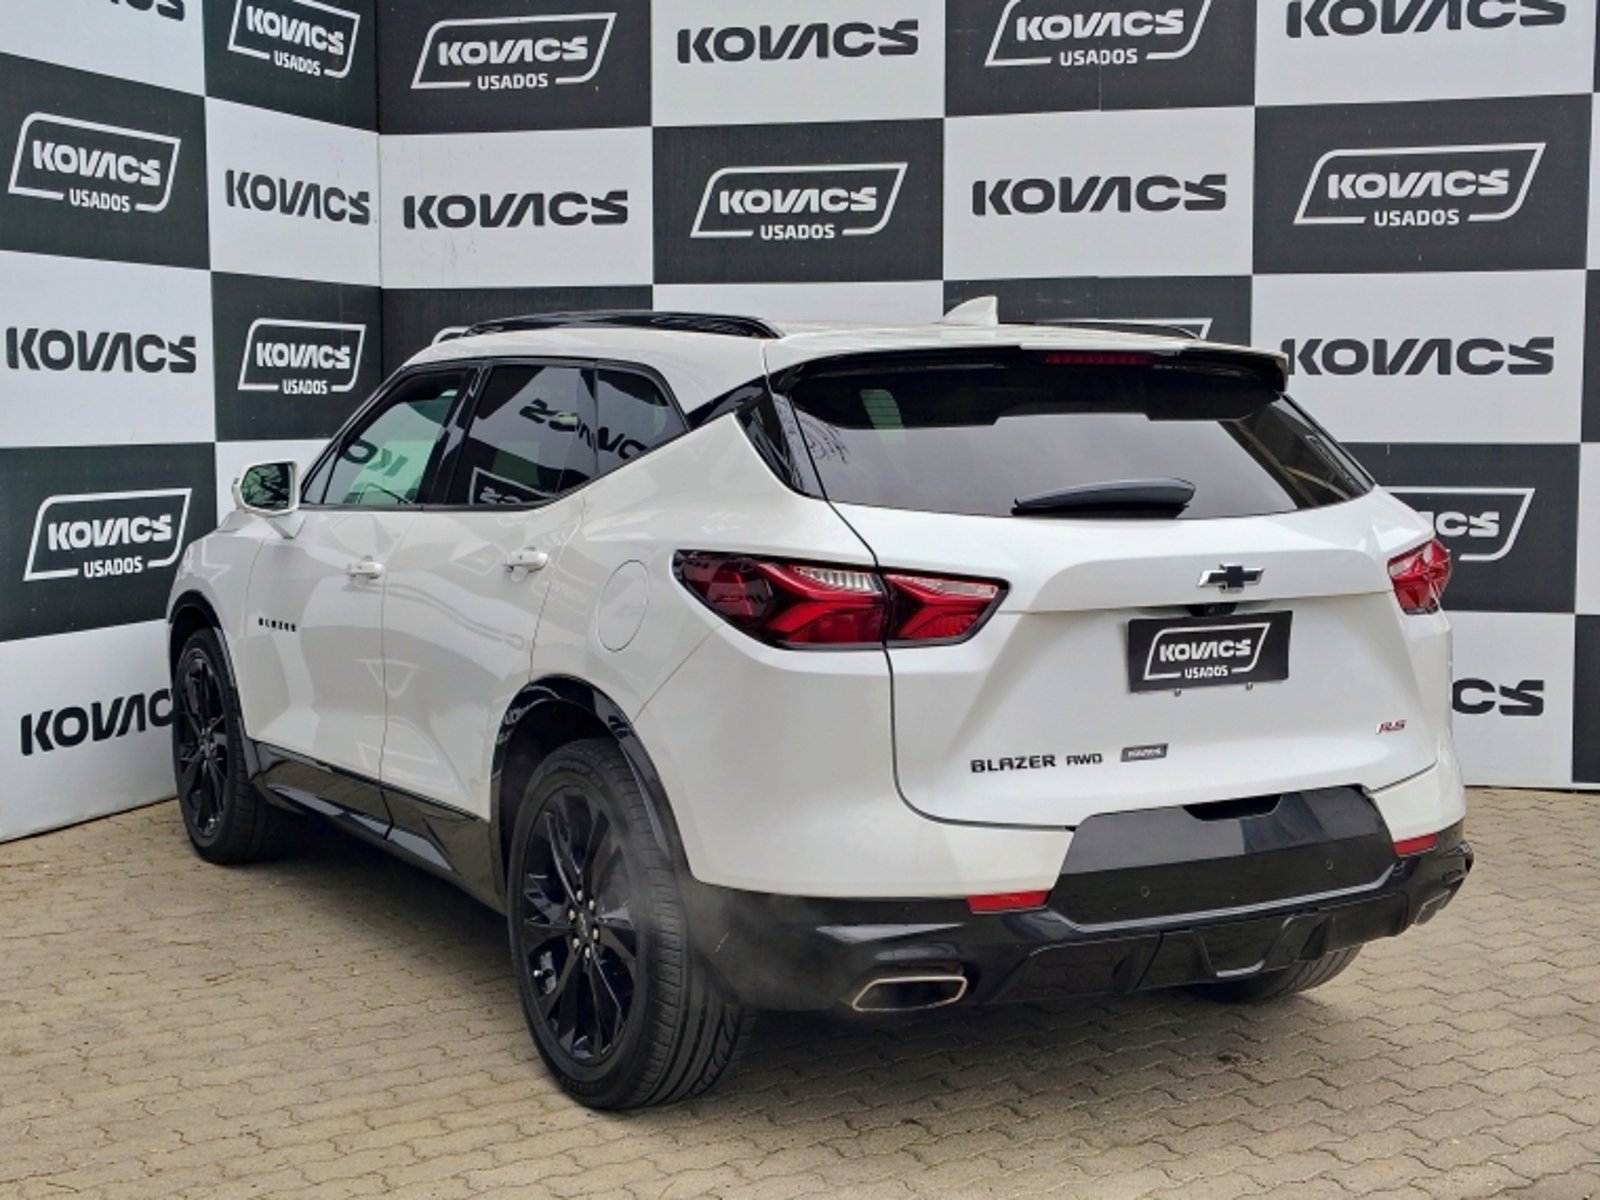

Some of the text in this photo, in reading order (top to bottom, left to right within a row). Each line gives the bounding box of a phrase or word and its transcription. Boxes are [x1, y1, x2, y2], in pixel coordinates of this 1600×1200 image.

[245, 5, 344, 56] KOVACS
[1016, 8, 1183, 41] KOVACS
[1287, 0, 1566, 38] KOVACS
[439, 37, 587, 65] KOVACS
[678, 20, 918, 63] KOVACS
[273, 49, 321, 76] USADOS
[1060, 48, 1137, 66] USADOS
[478, 73, 548, 90] USADOS
[33, 140, 161, 186] KOVACS
[226, 170, 369, 225] KOVACS
[973, 174, 1226, 215] KOVACS
[1328, 169, 1509, 199] KOVACS
[70, 189, 130, 212] USADOS
[404, 190, 628, 229] KOVACS
[720, 187, 876, 213] KOVACS
[1375, 209, 1459, 226] USADOS
[761, 224, 834, 240] USADOS
[6, 327, 196, 373] KOVACS
[257, 343, 350, 369] KOVACS
[1281, 338, 1554, 376] KOVACS
[283, 379, 327, 394] USADOS
[48, 515, 173, 550] KOVACS
[84, 556, 143, 578] USADOS
[1159, 639, 1251, 662] KOVACS
[1185, 665, 1228, 678] USADOS
[21, 688, 172, 756] KOVAC
[971, 753, 1102, 773] BLAZER AWD
